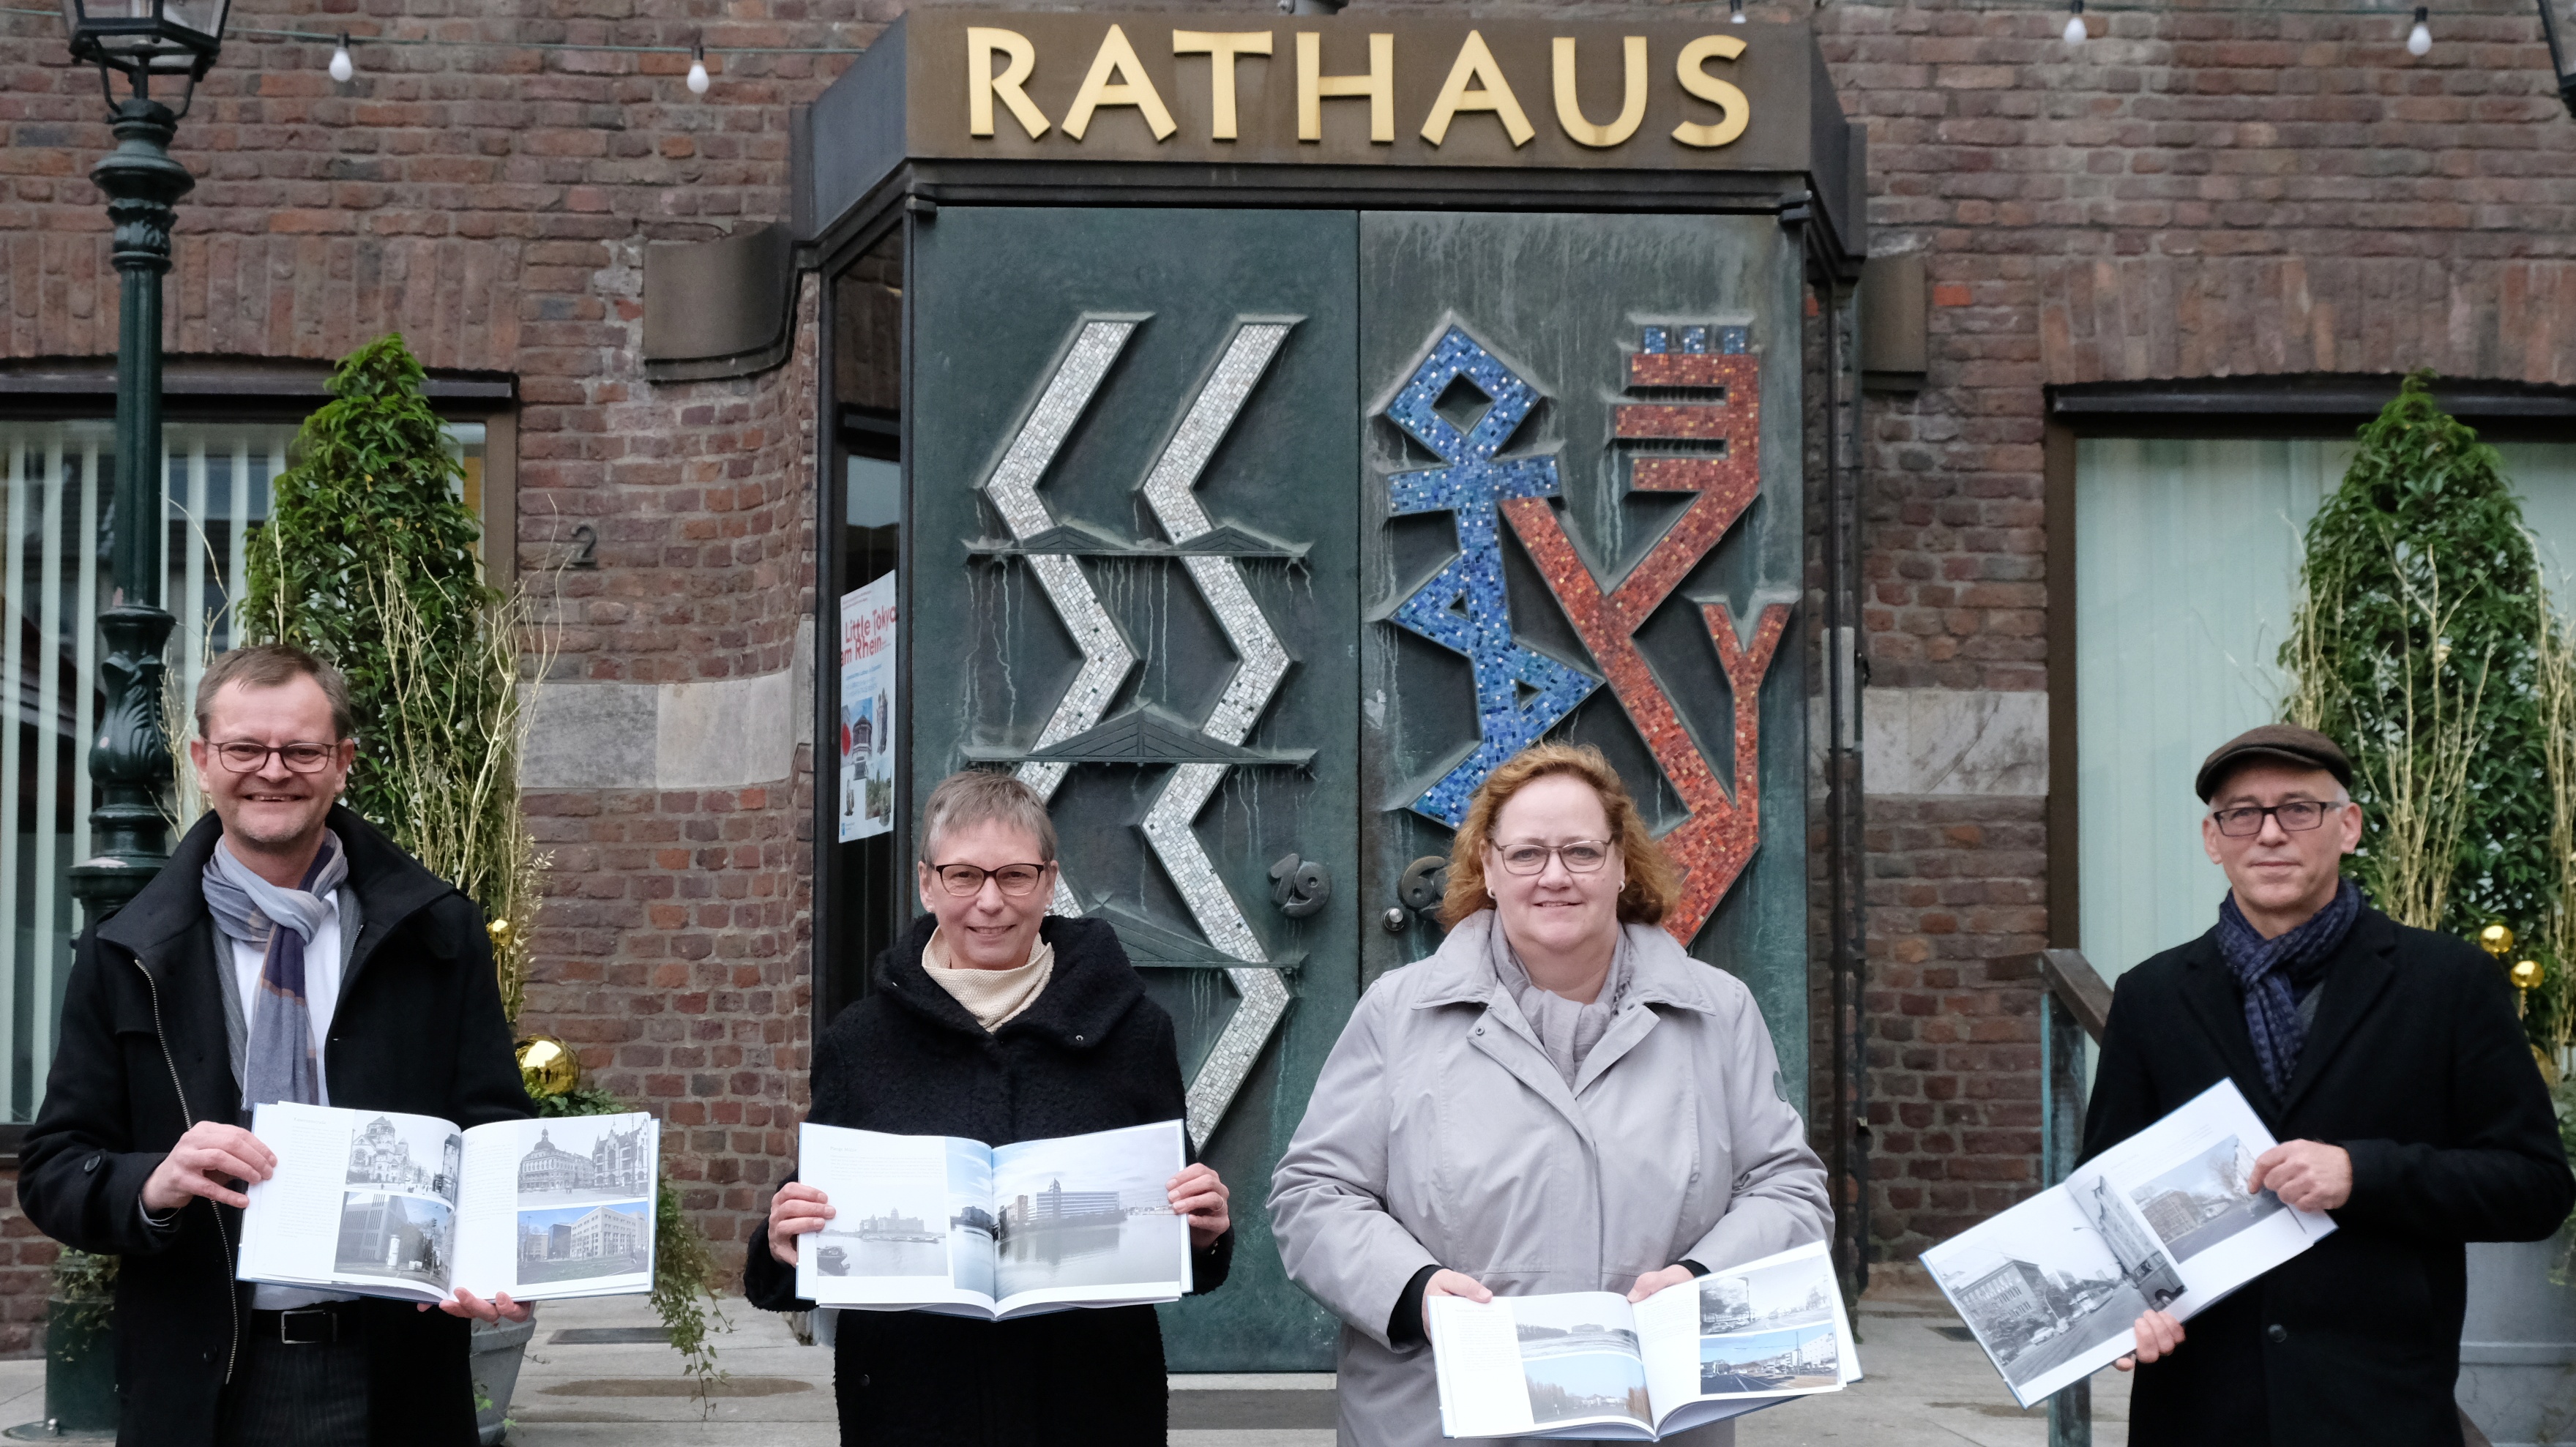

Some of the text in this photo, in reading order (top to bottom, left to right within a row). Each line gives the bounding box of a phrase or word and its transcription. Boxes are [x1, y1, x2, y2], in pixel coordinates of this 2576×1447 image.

[966, 23, 1750, 149] RATHAUS
[571, 524, 597, 569] 2
[845, 605, 897, 643] Little Tokyo
[854, 635, 882, 660] Rhein
[1269, 852, 1332, 919] 19
